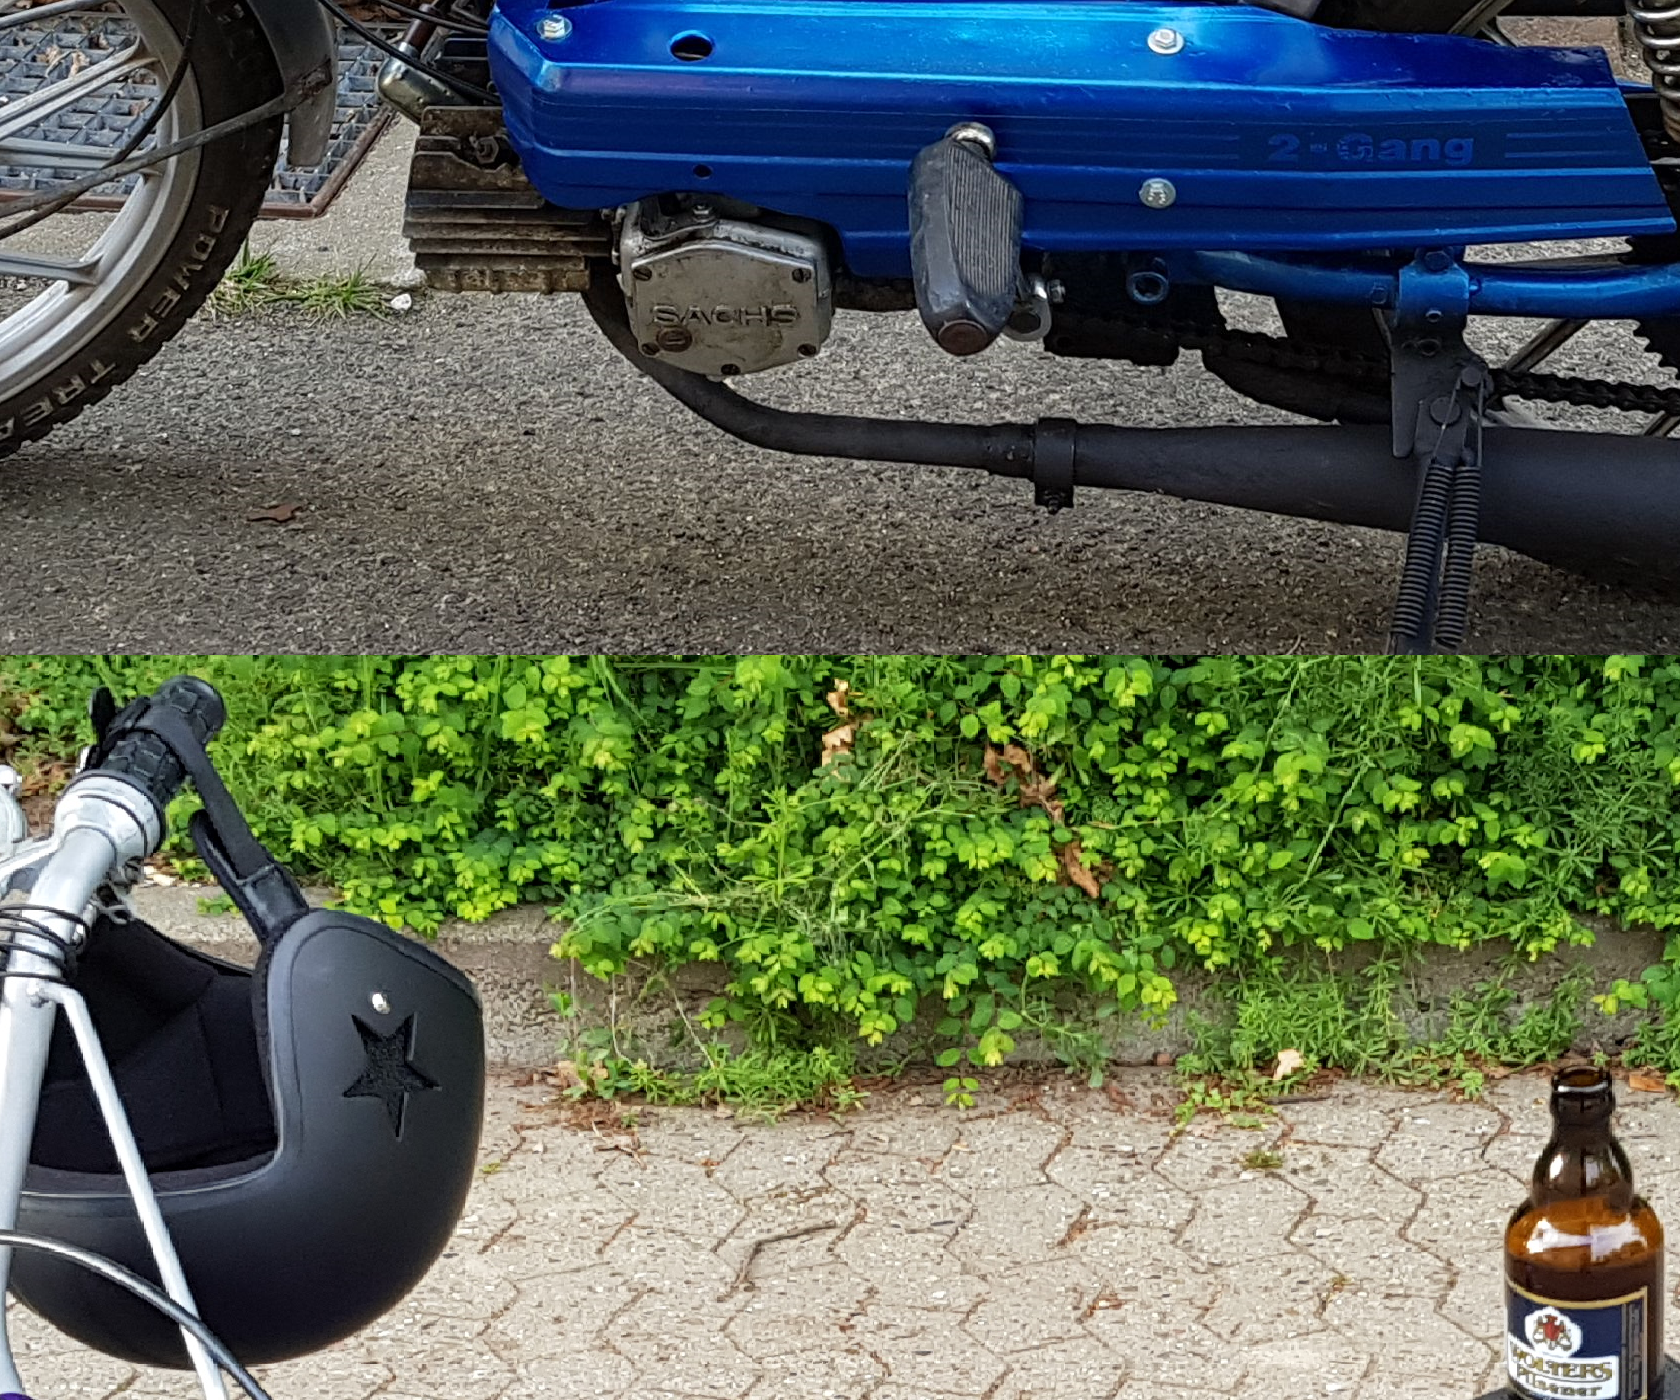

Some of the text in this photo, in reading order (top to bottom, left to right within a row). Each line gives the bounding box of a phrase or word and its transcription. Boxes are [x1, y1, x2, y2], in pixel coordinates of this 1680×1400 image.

[1268, 132, 1475, 166] 2-Gang
[127, 204, 230, 344] POWER
[651, 304, 800, 328] SACHS
